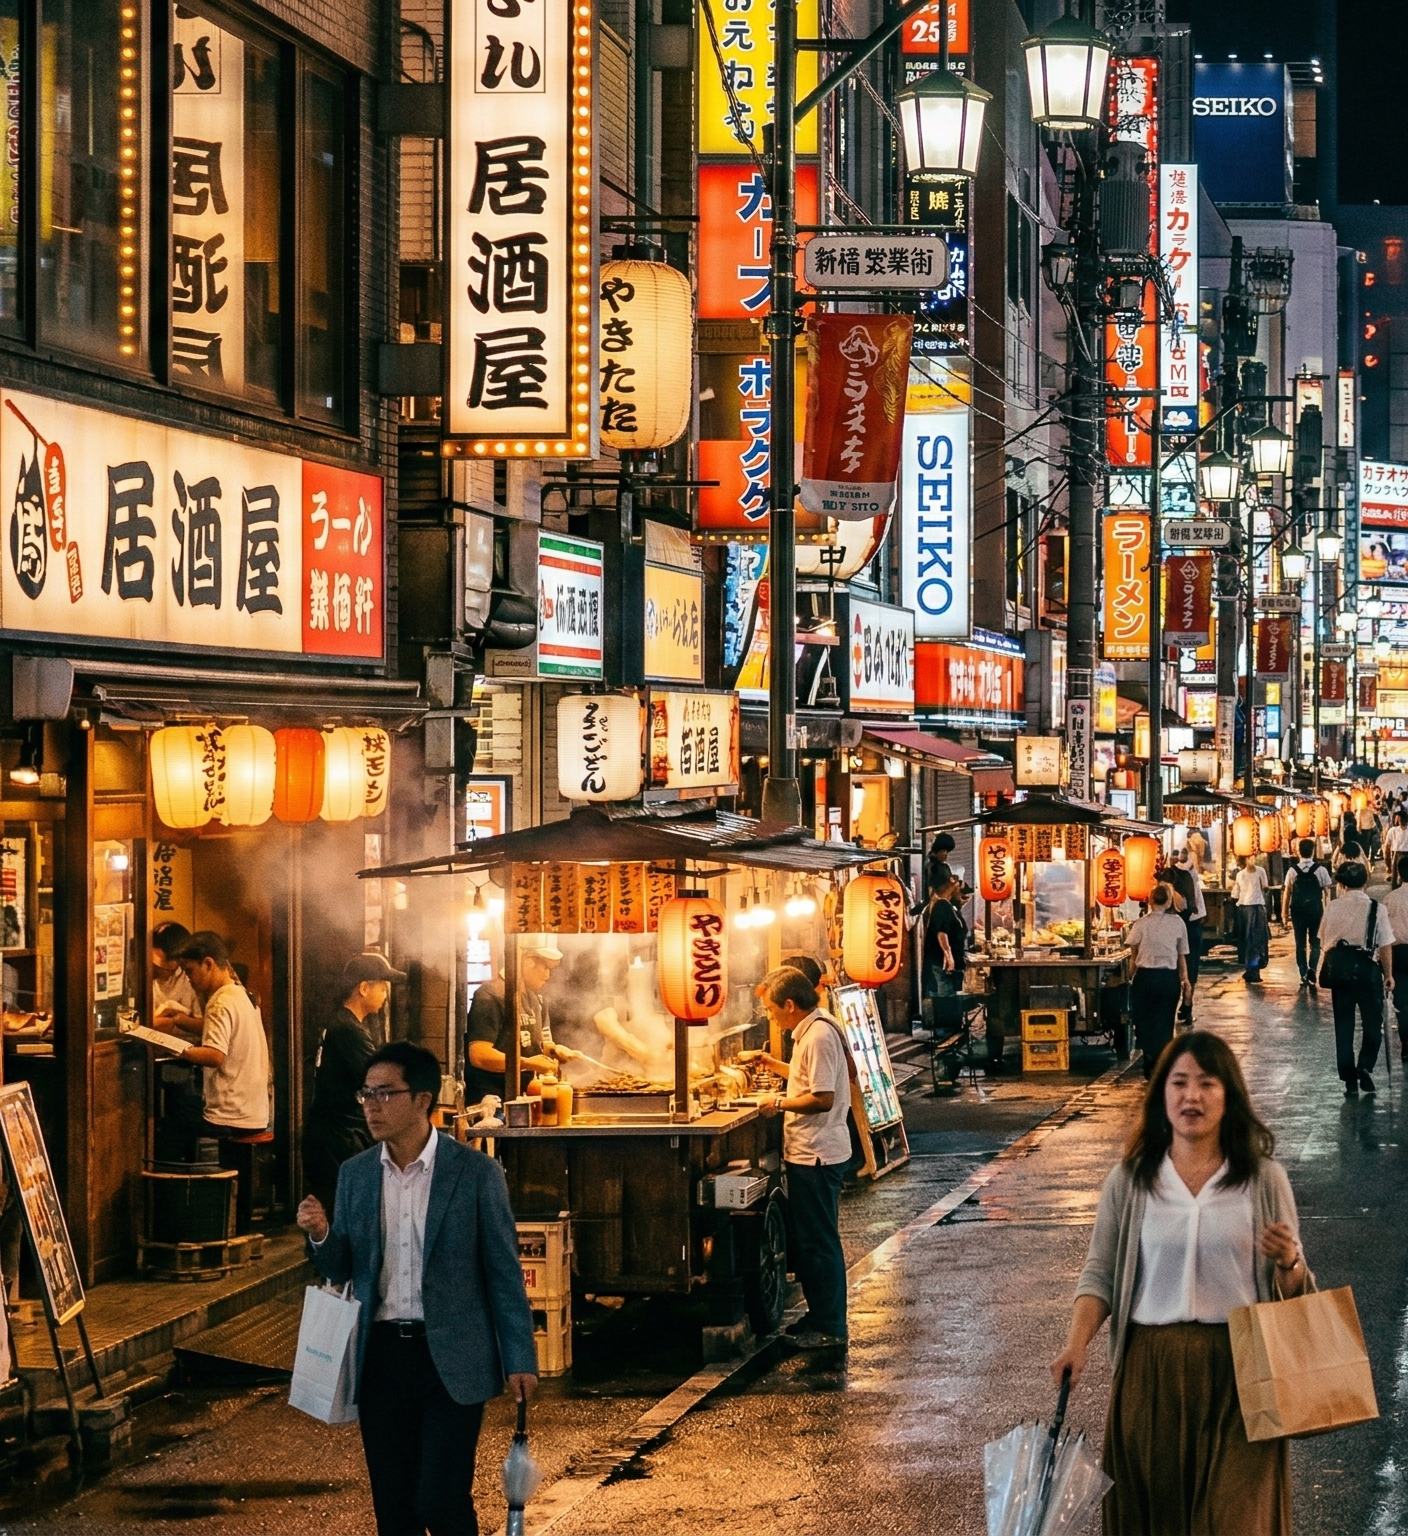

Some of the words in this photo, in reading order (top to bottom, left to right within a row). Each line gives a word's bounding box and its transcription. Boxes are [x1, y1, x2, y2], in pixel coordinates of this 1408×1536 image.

[1192, 97, 1277, 117] SEIKO
[466, 136, 549, 410] 居酒屋
[102, 461, 283, 616] 居酒屋
[916, 435, 954, 616] SEIKO
[1112, 520, 1146, 639] ラーメン
